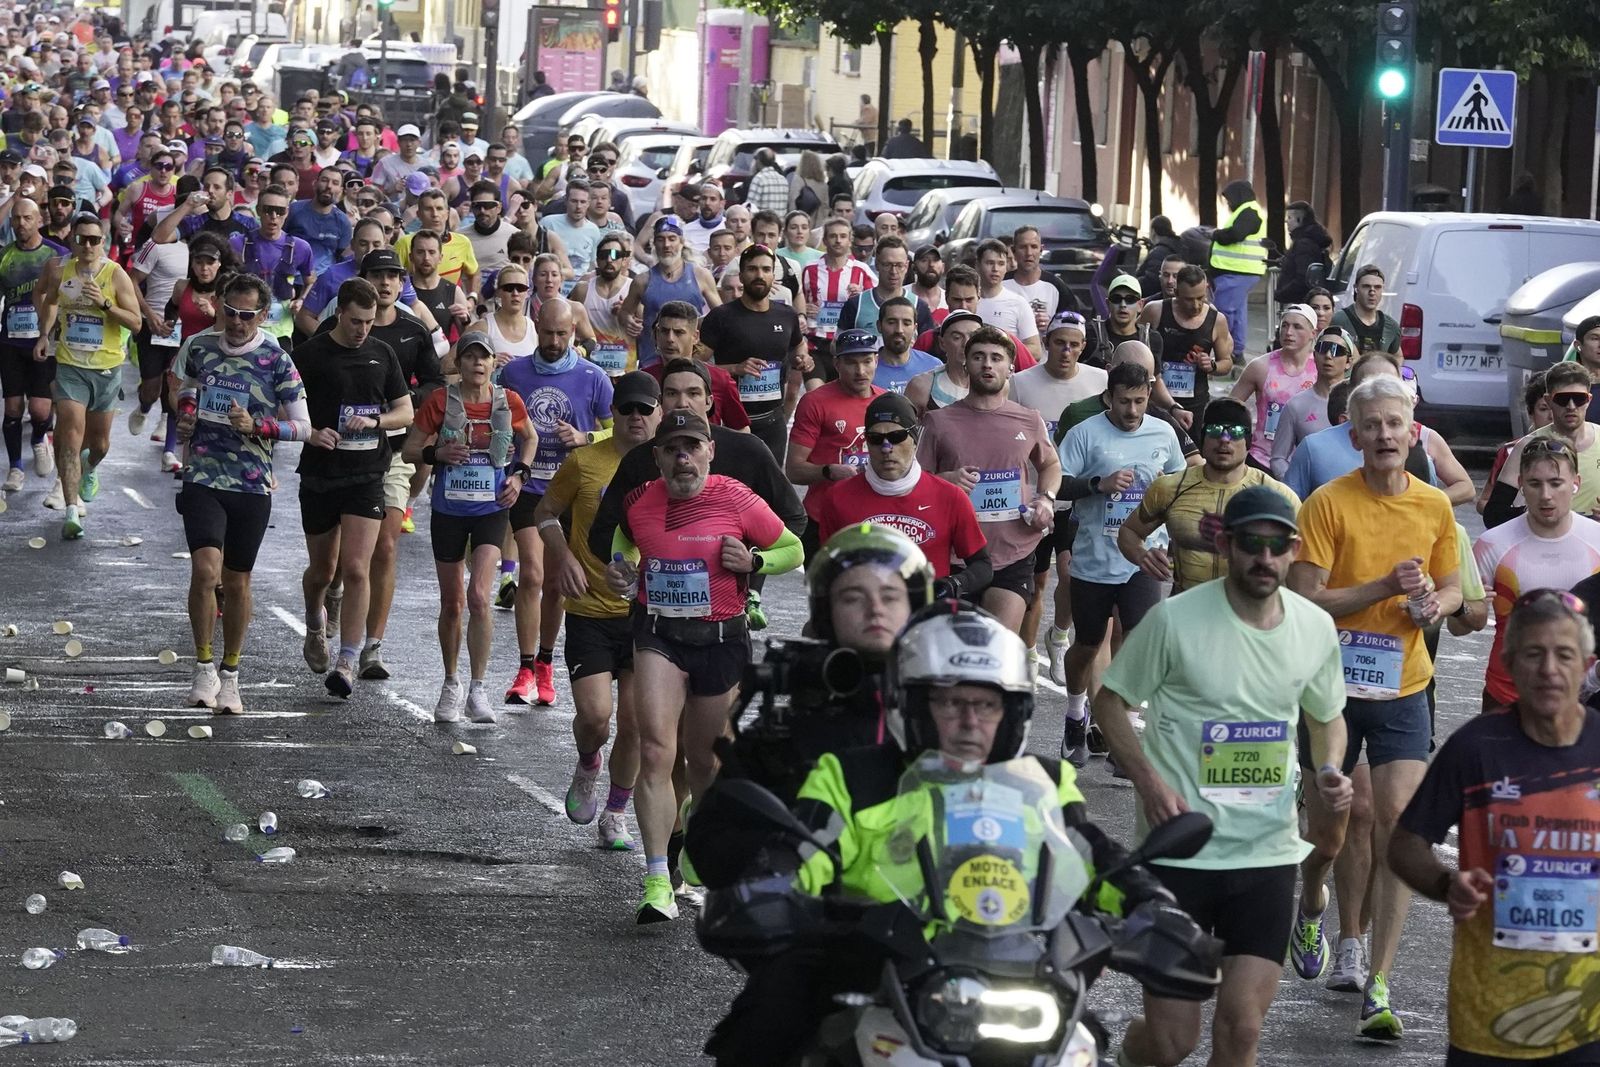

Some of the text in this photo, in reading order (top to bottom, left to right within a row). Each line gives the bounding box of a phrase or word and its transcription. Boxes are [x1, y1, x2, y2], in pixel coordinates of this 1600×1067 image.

[1446, 355, 1503, 368] 9177 MFY
[217, 379, 245, 391] ZURICH
[740, 383, 779, 393] FRANCESCO
[676, 415, 685, 426] B
[984, 471, 1015, 480] ZURICH
[450, 479, 490, 490] MICHELE
[985, 487, 1003, 496] 6844
[980, 497, 1008, 510] JACK
[897, 517, 926, 531] AMERICA
[664, 562, 700, 572] ZURICH
[666, 580, 685, 589] 8067
[648, 589, 709, 604] ESPIÑEIRA
[1356, 635, 1396, 648] ZURICH
[1355, 654, 1376, 666] 7064
[1343, 666, 1385, 685] PETER
[1234, 726, 1281, 739] ZURICH
[1233, 751, 1260, 762] 2720
[1207, 766, 1282, 785] ILLESCAS
[969, 861, 1009, 875] MOTO
[1532, 859, 1592, 875] ZURICH
[962, 875, 1016, 892] ENLACE
[1510, 906, 1585, 928] CARLOS
